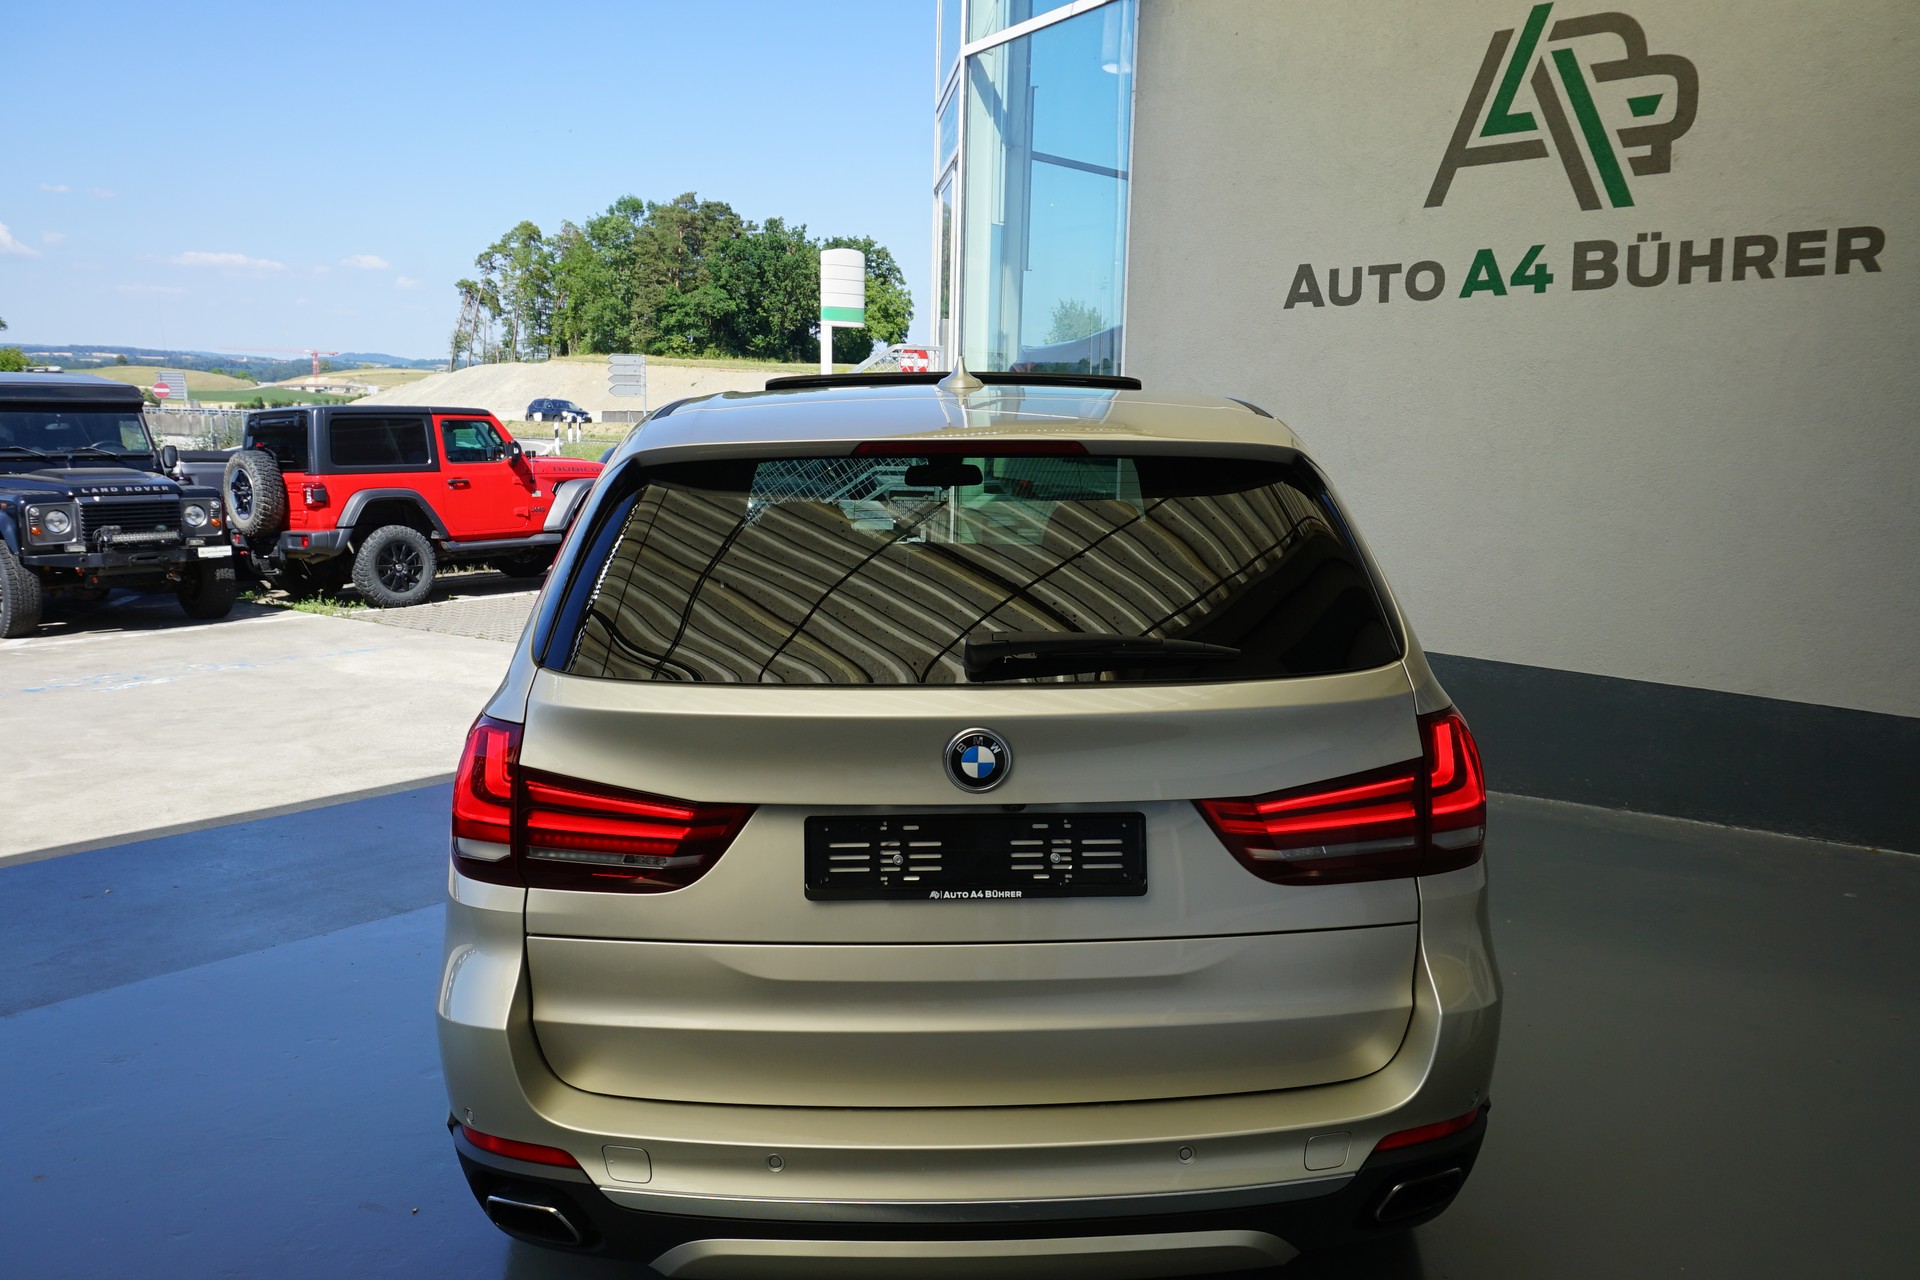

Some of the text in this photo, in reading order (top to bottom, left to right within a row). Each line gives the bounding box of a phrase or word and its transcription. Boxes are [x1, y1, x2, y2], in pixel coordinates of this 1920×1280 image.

[1283, 225, 1887, 310] AUTO A4 BÜHRER
[956, 736, 1002, 754] BMW
[943, 890, 969, 899] AUTO
[970, 889, 984, 899] A4
[985, 889, 1022, 898] BÜHRER
